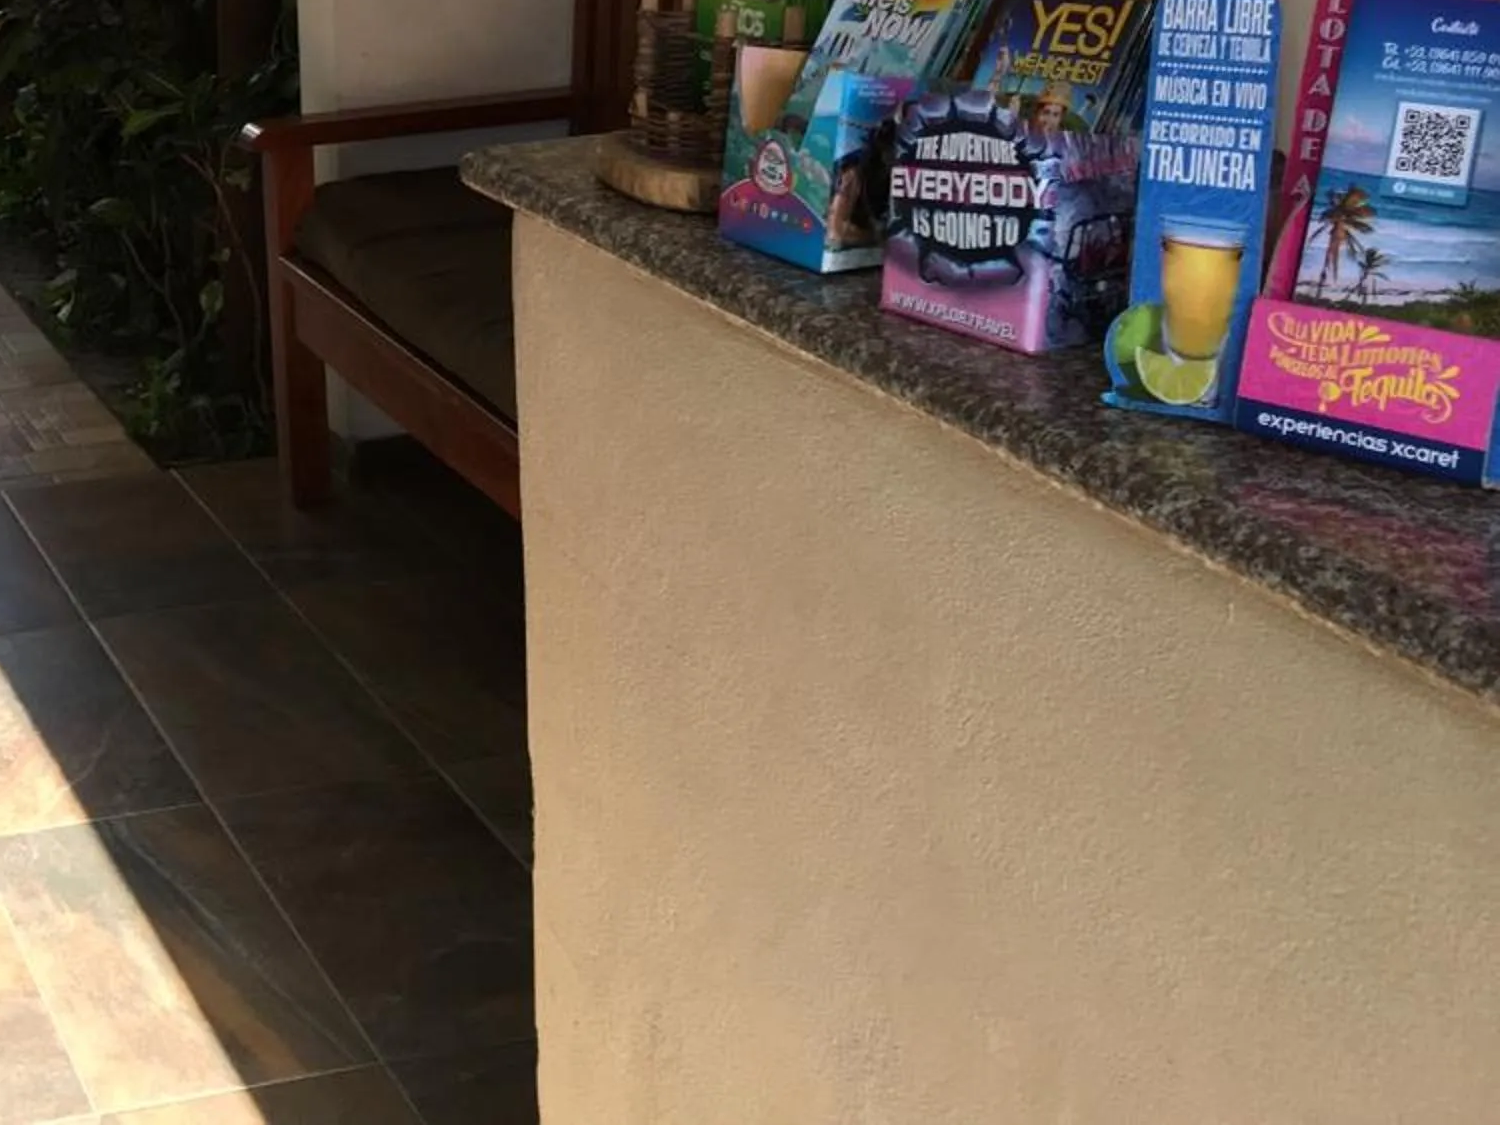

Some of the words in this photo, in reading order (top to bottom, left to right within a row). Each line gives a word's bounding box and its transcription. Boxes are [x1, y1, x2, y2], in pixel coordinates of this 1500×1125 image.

[1158, 31, 1173, 57] DE
[1173, 32, 1218, 60] CERVEZA
[1219, 35, 1227, 60] Y
[1229, 36, 1272, 64] TEQUILA
[1154, 69, 1209, 105] MÚSICA
[1211, 79, 1231, 107] EN
[1233, 81, 1269, 111] VIVO
[915, 136, 940, 159] THE
[940, 131, 1019, 165] ADVENTURE
[1149, 117, 1236, 149] RECORRIDO
[1238, 127, 1263, 151] EN
[891, 166, 1049, 210] EVERYBODY
[1145, 143, 1256, 192] TRAJINERA
[912, 208, 931, 238] IS
[932, 210, 992, 250] GOING
[994, 215, 1020, 247] TO
[1310, 319, 1357, 344] VIDA
[1341, 365, 1450, 415] Tequila
[1257, 411, 1389, 452] experiencias
[1390, 441, 1460, 469] xcaret
